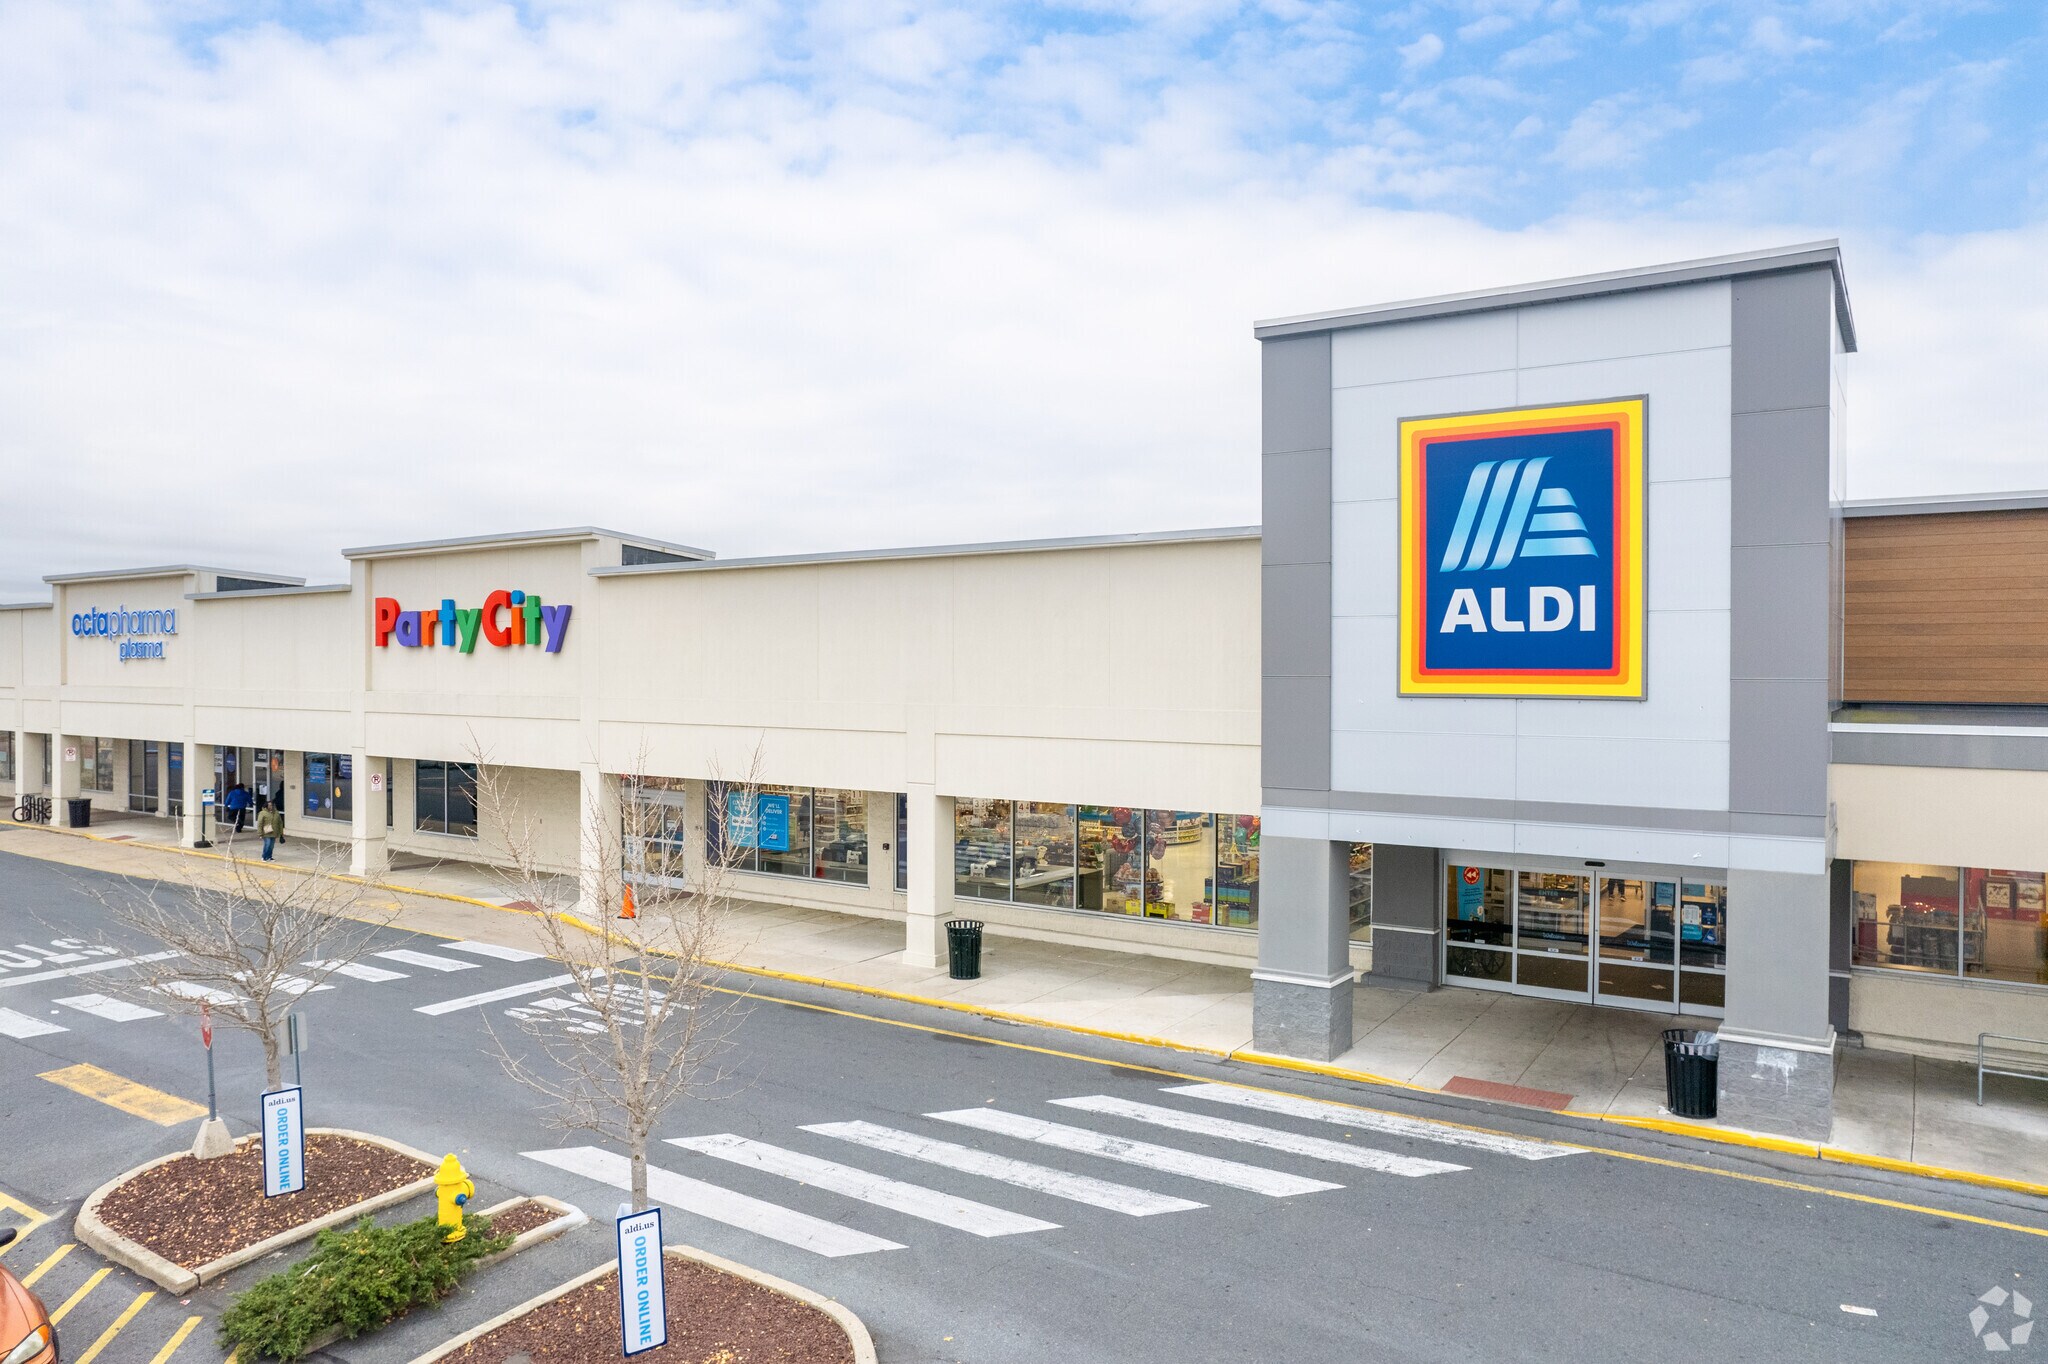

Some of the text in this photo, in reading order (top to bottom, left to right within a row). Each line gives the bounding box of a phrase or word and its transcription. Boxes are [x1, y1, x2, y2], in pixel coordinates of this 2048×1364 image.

[72, 604, 176, 641] octapharma
[1440, 585, 1596, 633] ALDI
[119, 637, 164, 662] plasma
[1538, 889, 1559, 897] ENTER
[0, 938, 120, 973] STO
[267, 1096, 296, 1107] aldi.us
[276, 1107, 291, 1191] ORDER ONLINE
[624, 1220, 655, 1235] aldi.us
[634, 1235, 652, 1346] ORDER ONLINE
